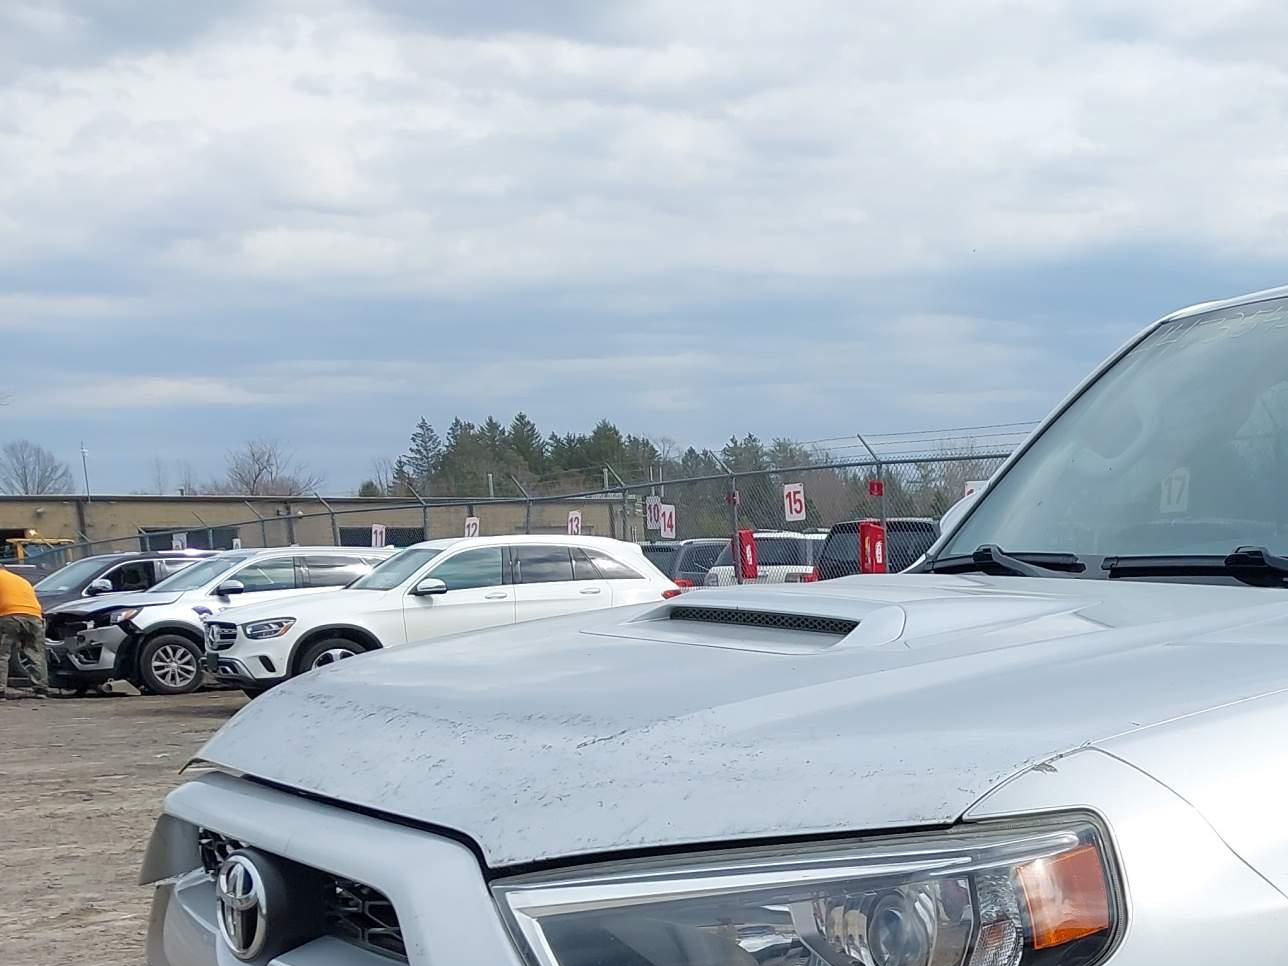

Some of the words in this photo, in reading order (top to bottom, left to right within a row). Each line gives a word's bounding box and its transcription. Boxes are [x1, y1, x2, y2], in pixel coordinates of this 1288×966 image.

[785, 491, 804, 515] 15
[466, 522, 478, 537] 12
[568, 516, 580, 535] 13
[661, 510, 674, 533] 14
[373, 529, 385, 547] 11
